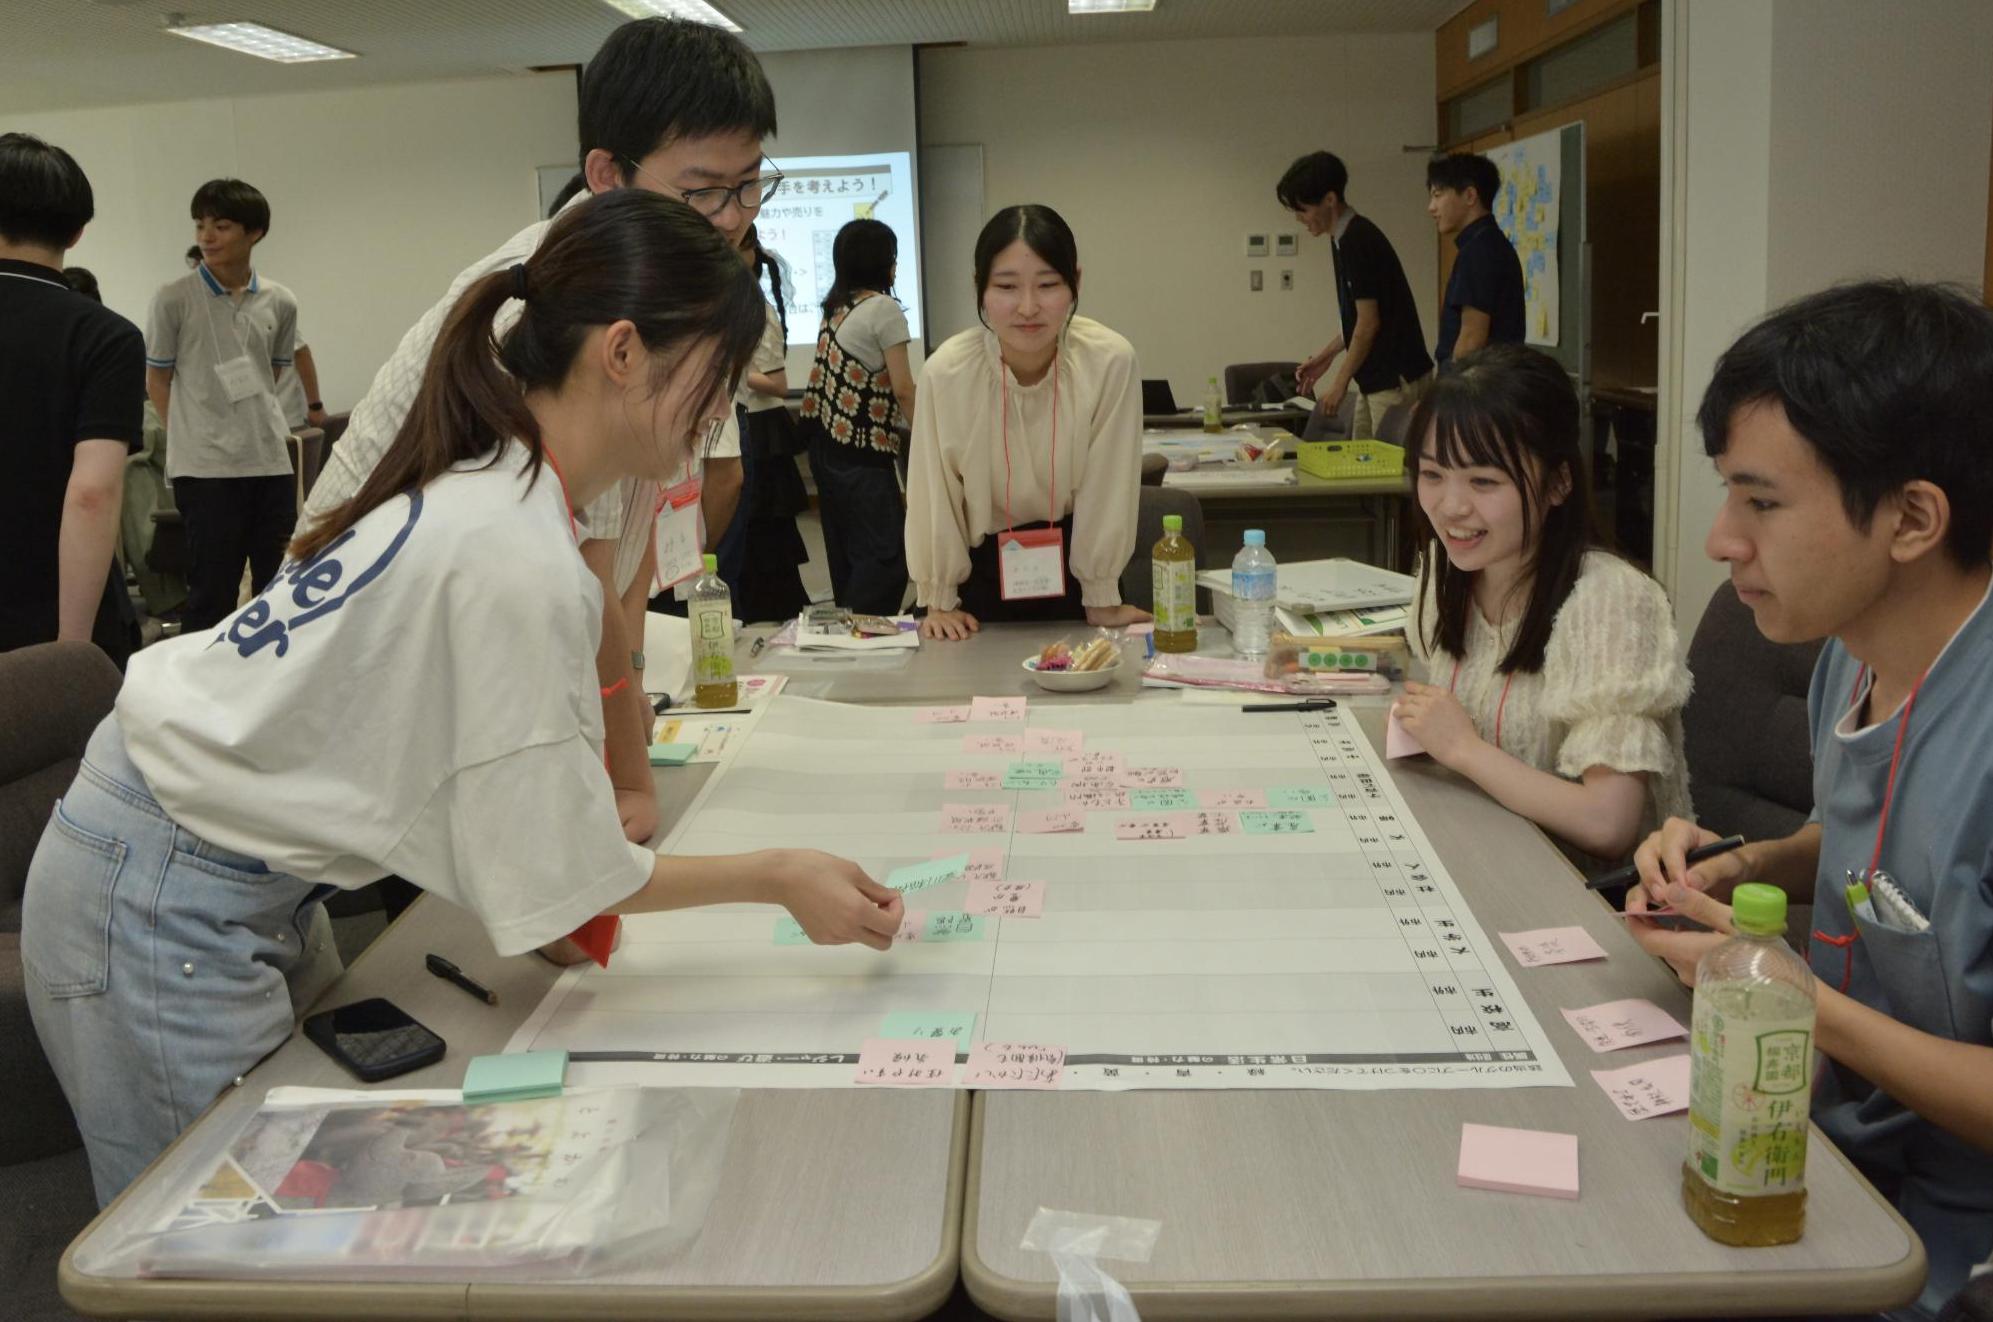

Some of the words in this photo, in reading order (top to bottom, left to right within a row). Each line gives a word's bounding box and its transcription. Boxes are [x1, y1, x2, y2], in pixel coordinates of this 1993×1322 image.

[1372, 861, 1392, 869] 市外
[1404, 863, 1434, 894] 社会人
[1383, 888, 1406, 896] 市内
[1398, 917, 1422, 927] 市外
[1434, 919, 1470, 955] 大学生
[1413, 949, 1439, 958] 市内
[1431, 985, 1457, 995] 市外
[1471, 987, 1514, 1032] 高校生
[1449, 1024, 1478, 1036] 市内
[736, 1053, 846, 1063] レジャー・遊び
[1130, 1055, 1215, 1064] の魅力・特徴
[1226, 1054, 1307, 1065] 日常生活
[1763, 1098, 1794, 1187] 伊右衛門
